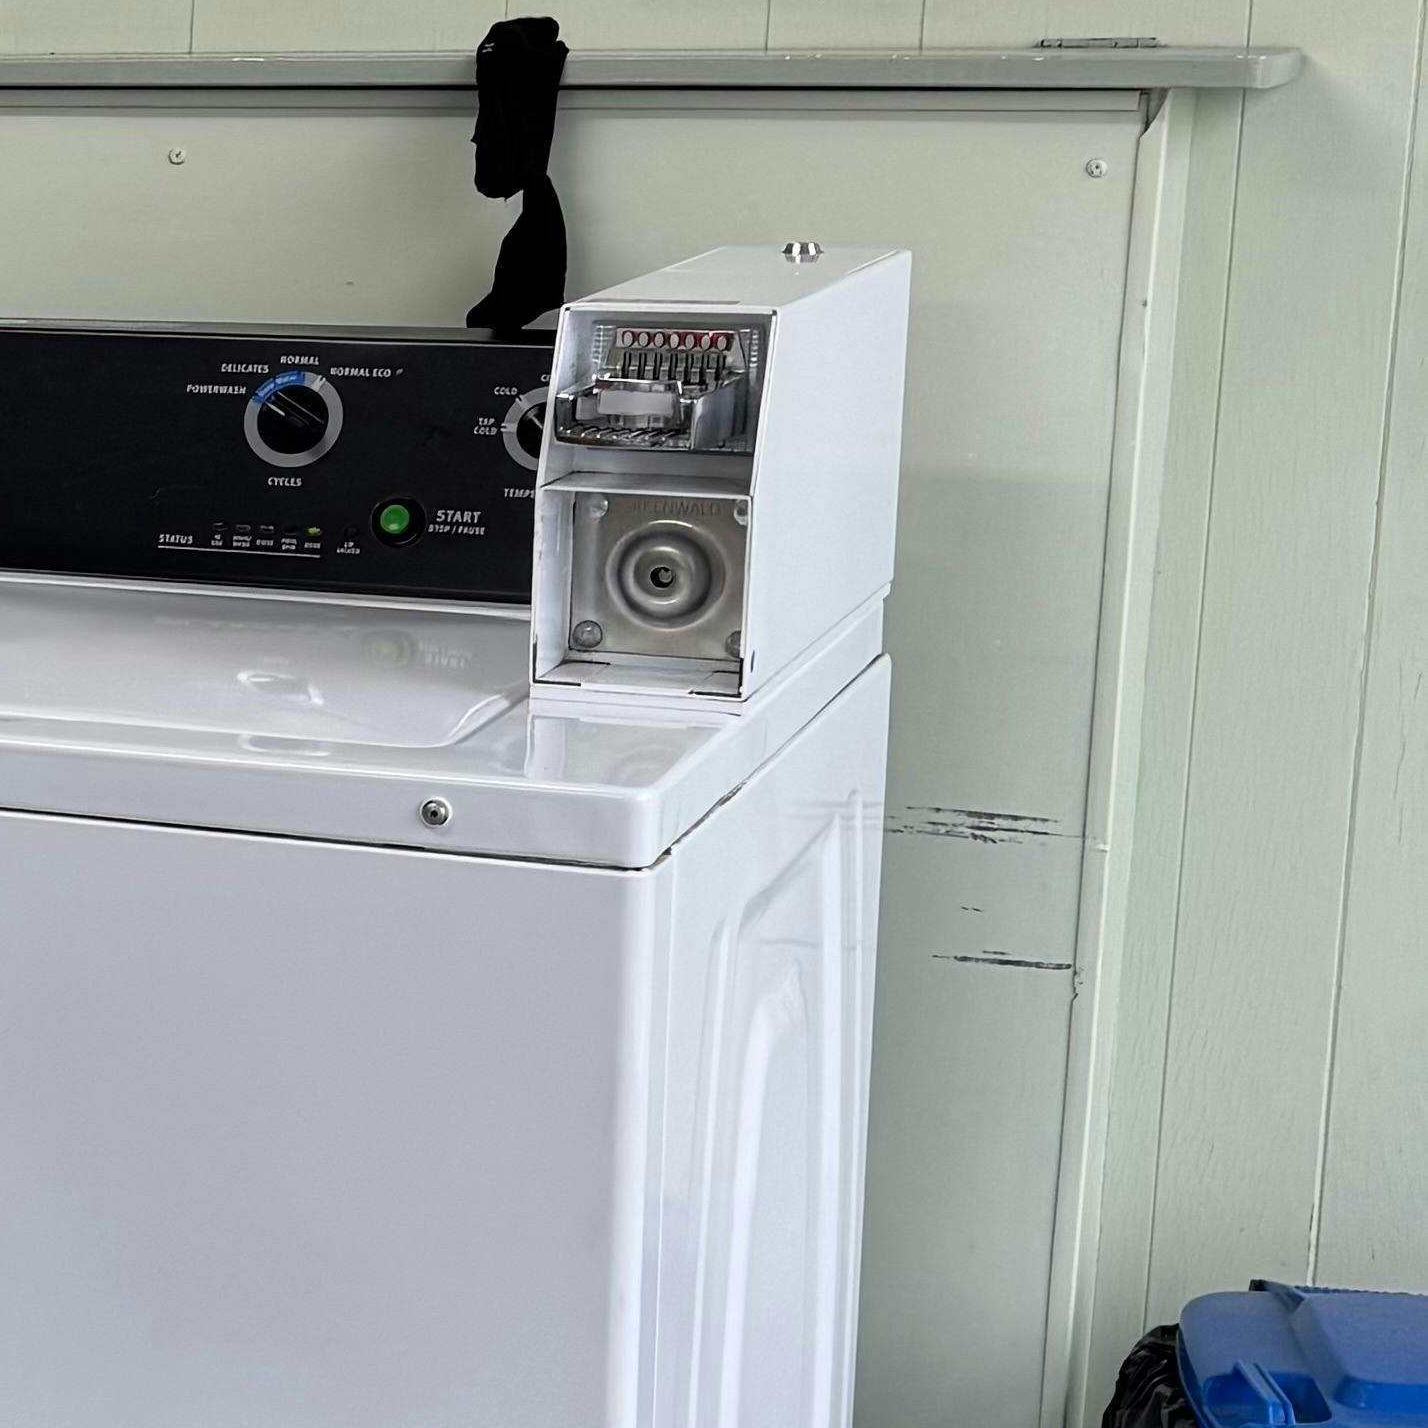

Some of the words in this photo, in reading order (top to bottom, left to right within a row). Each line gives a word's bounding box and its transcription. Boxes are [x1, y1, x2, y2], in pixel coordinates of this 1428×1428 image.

[280, 355, 319, 366] NORMAL
[220, 363, 269, 374] DELICATES
[330, 367, 371, 377] NORMAL
[372, 367, 392, 378] ECO
[186, 384, 247, 395] POWERWASH
[494, 386, 518, 396] COLD
[473, 426, 498, 436] COLD
[267, 477, 302, 487] CYCLES
[436, 509, 482, 524] START
[458, 525, 486, 536] PAUSE
[159, 534, 194, 545] STATUS
